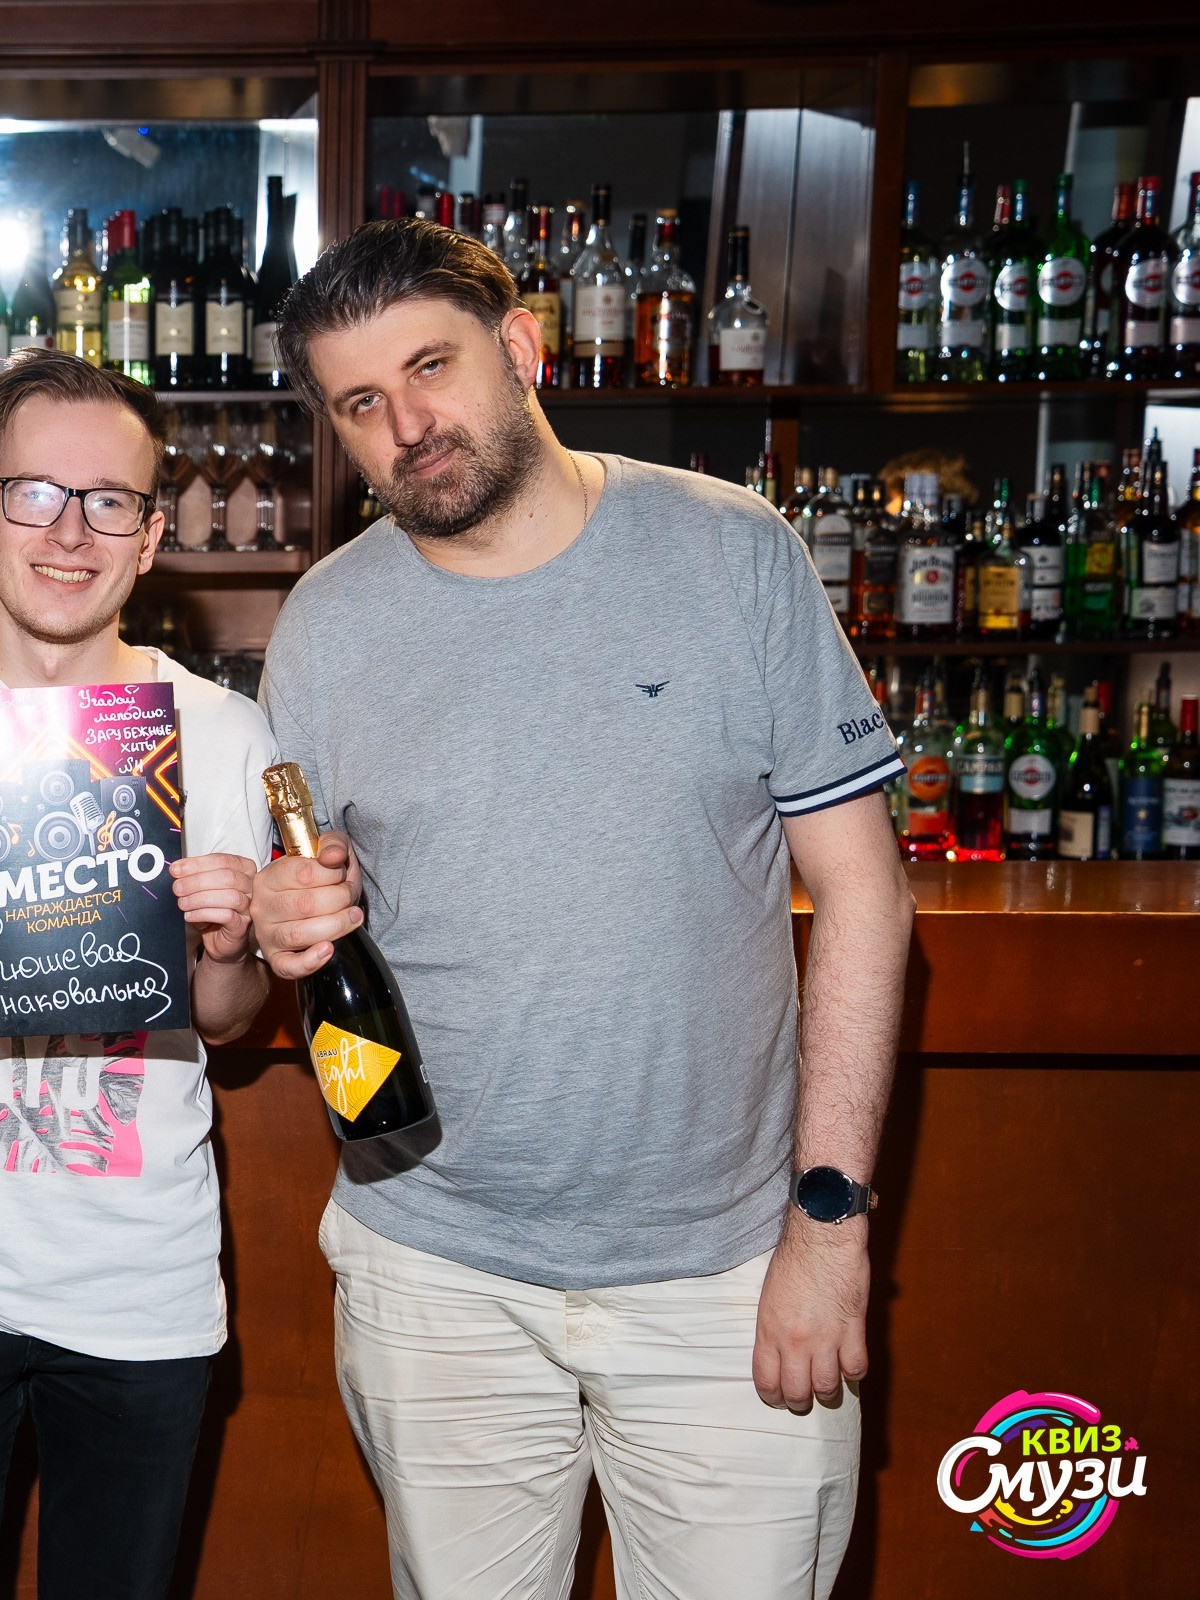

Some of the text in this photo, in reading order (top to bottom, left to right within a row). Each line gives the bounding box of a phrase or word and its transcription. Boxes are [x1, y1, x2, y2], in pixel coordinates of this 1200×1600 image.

[837, 708, 886, 745] Blac
[5, 889, 122, 922] НАГРАЖДАЕТСЯ
[27, 910, 102, 933] КОМАНДА
[0, 977, 172, 1023] наковальня
[313, 1036, 370, 1114] Light
